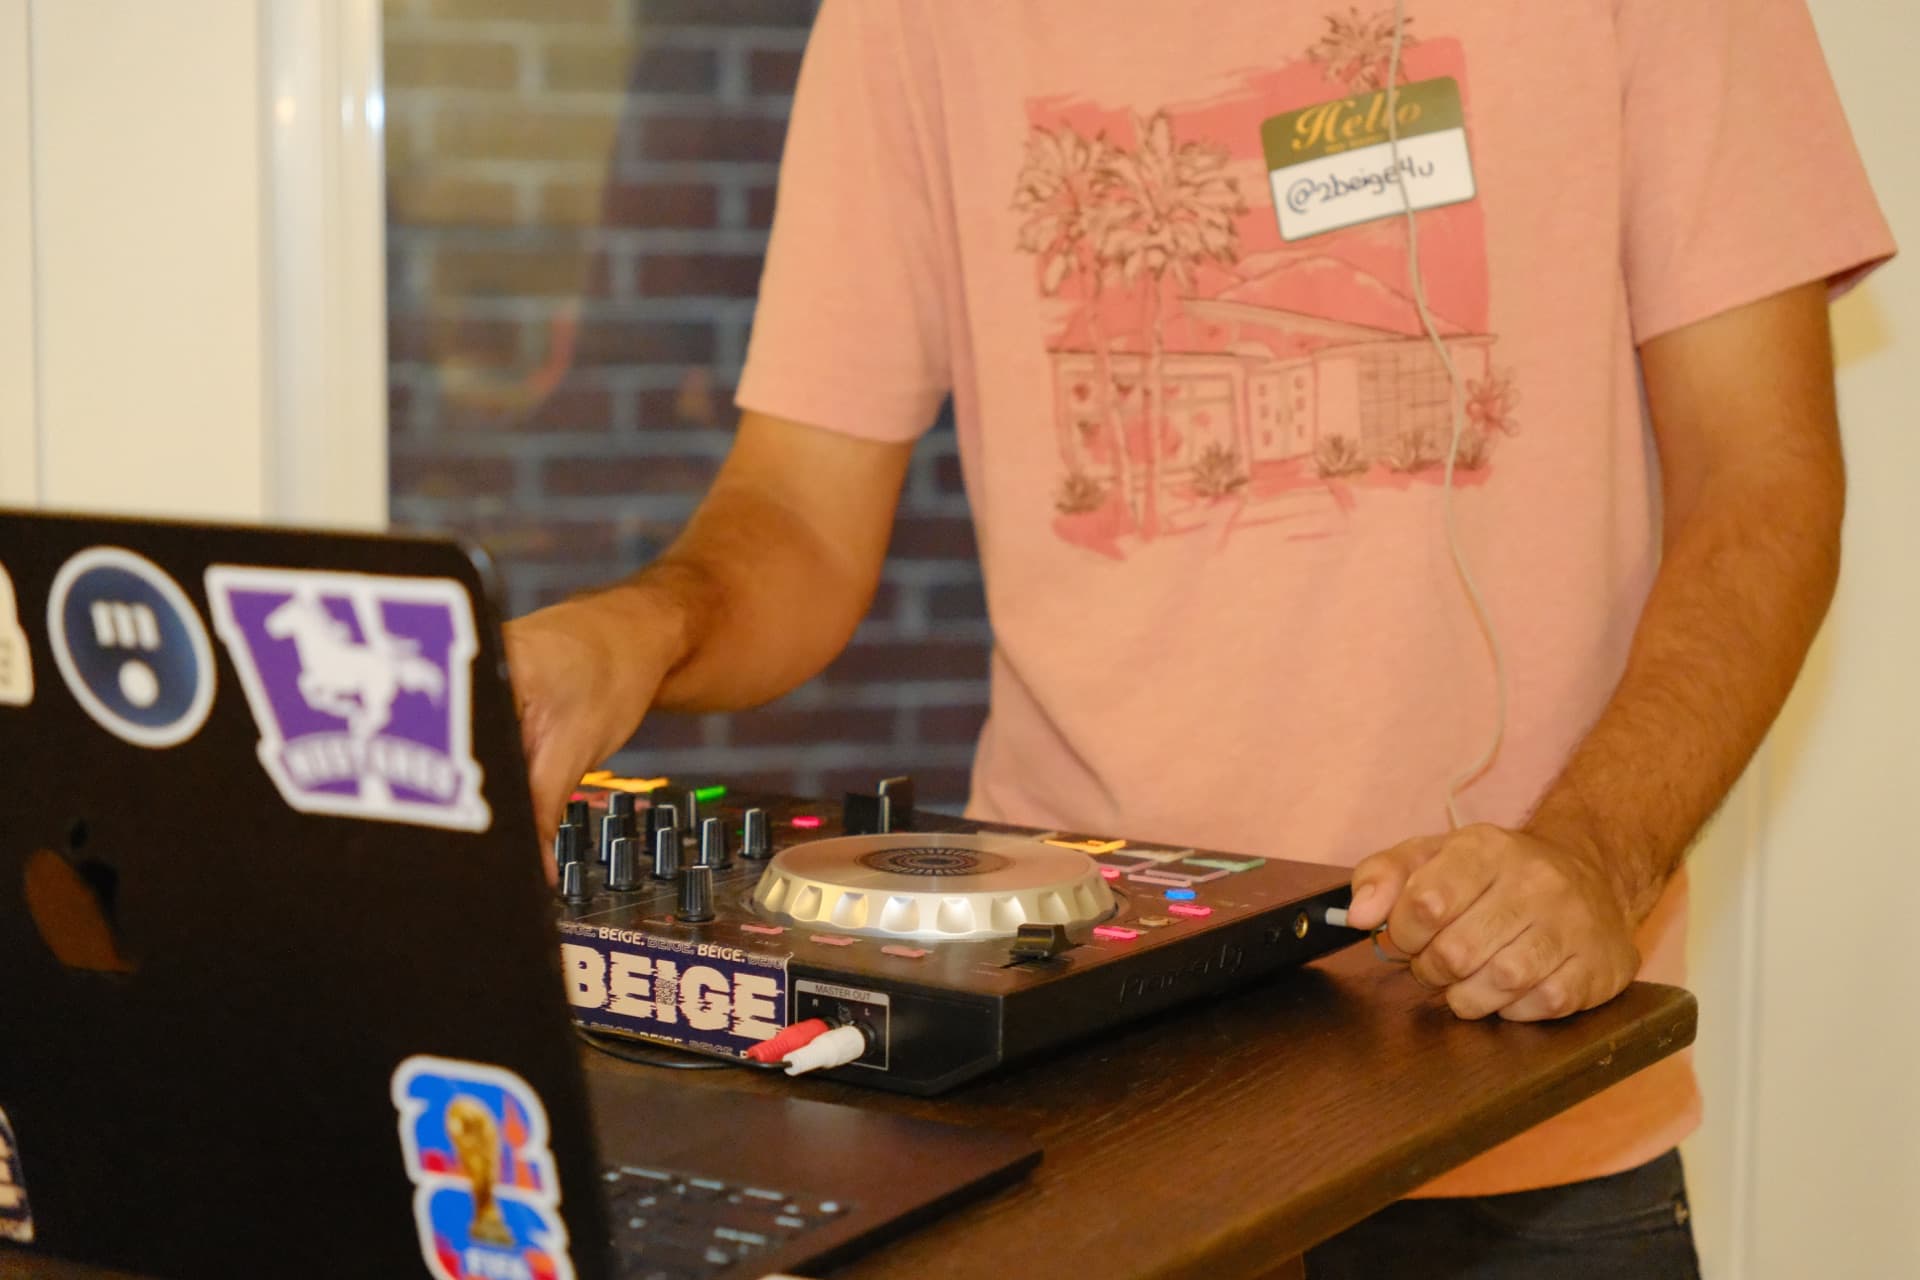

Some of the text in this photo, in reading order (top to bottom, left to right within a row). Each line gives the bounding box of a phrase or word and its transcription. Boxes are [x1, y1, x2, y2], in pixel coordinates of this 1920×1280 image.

[599, 926, 645, 946] BEIGE.
[697, 943, 746, 963] BEIGE.
[560, 942, 787, 1042] BEIGE
[815, 984, 871, 1001] MASTER OUT
